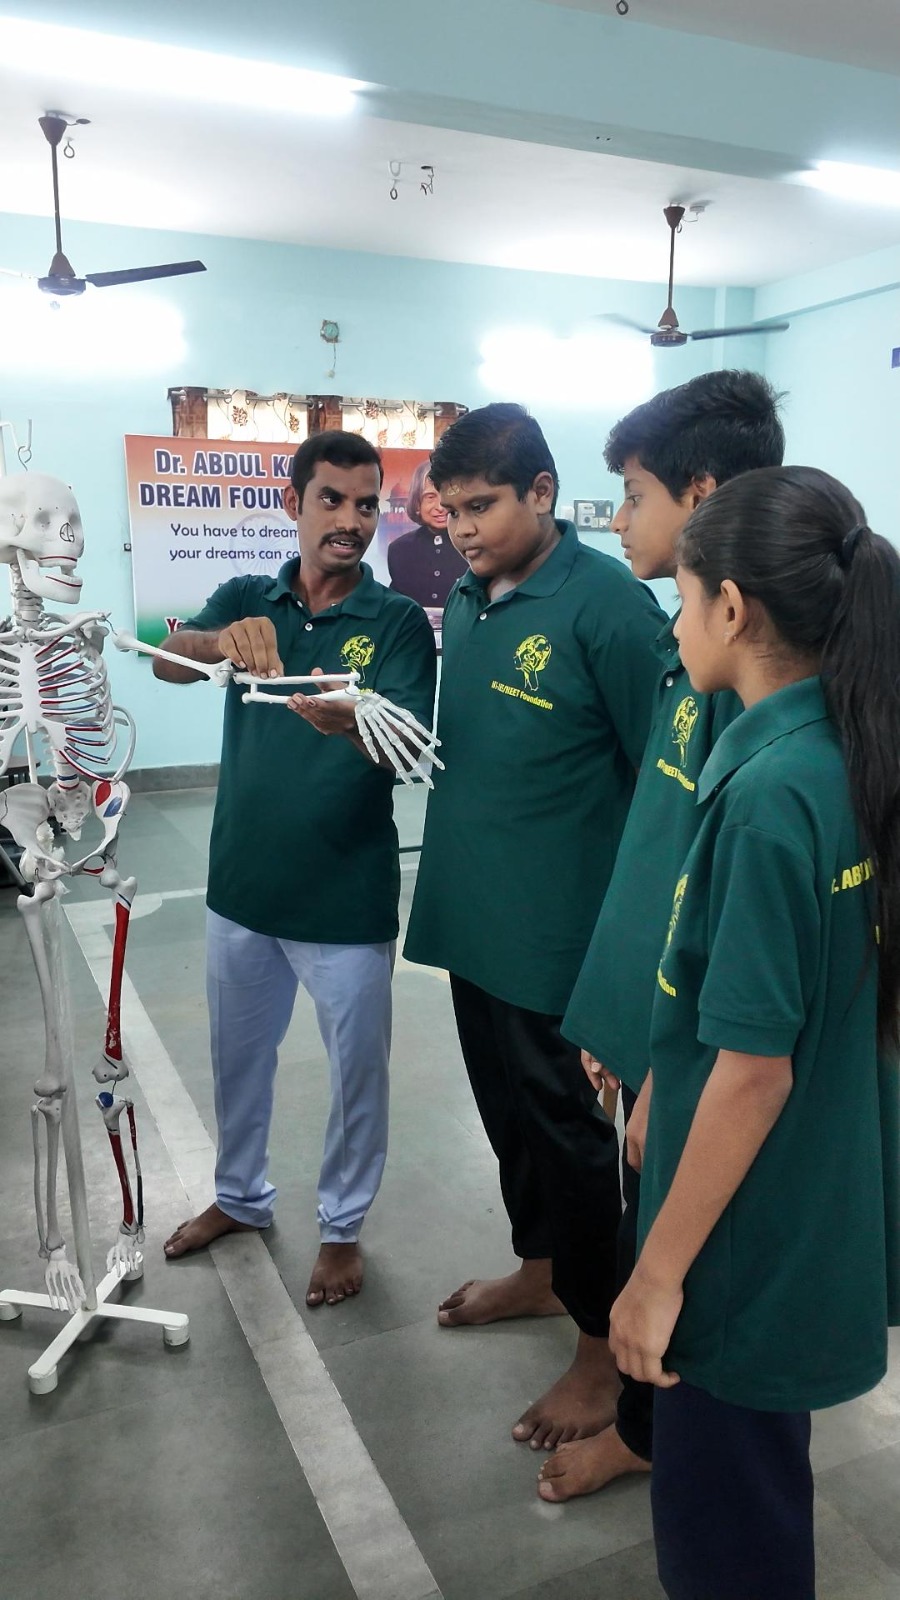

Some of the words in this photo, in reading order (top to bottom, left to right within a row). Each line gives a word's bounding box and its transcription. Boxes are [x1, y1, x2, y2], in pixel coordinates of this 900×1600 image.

[155, 449, 187, 475] Dr.
[193, 451, 267, 478] ABDUL
[139, 482, 222, 509] DREAM
[170, 523, 199, 537] You
[203, 523, 238, 537] have
[241, 525, 256, 538] to
[169, 549, 202, 561] your
[205, 546, 256, 560] dreams
[258, 549, 282, 560] can
[519, 691, 554, 711] Foundation
